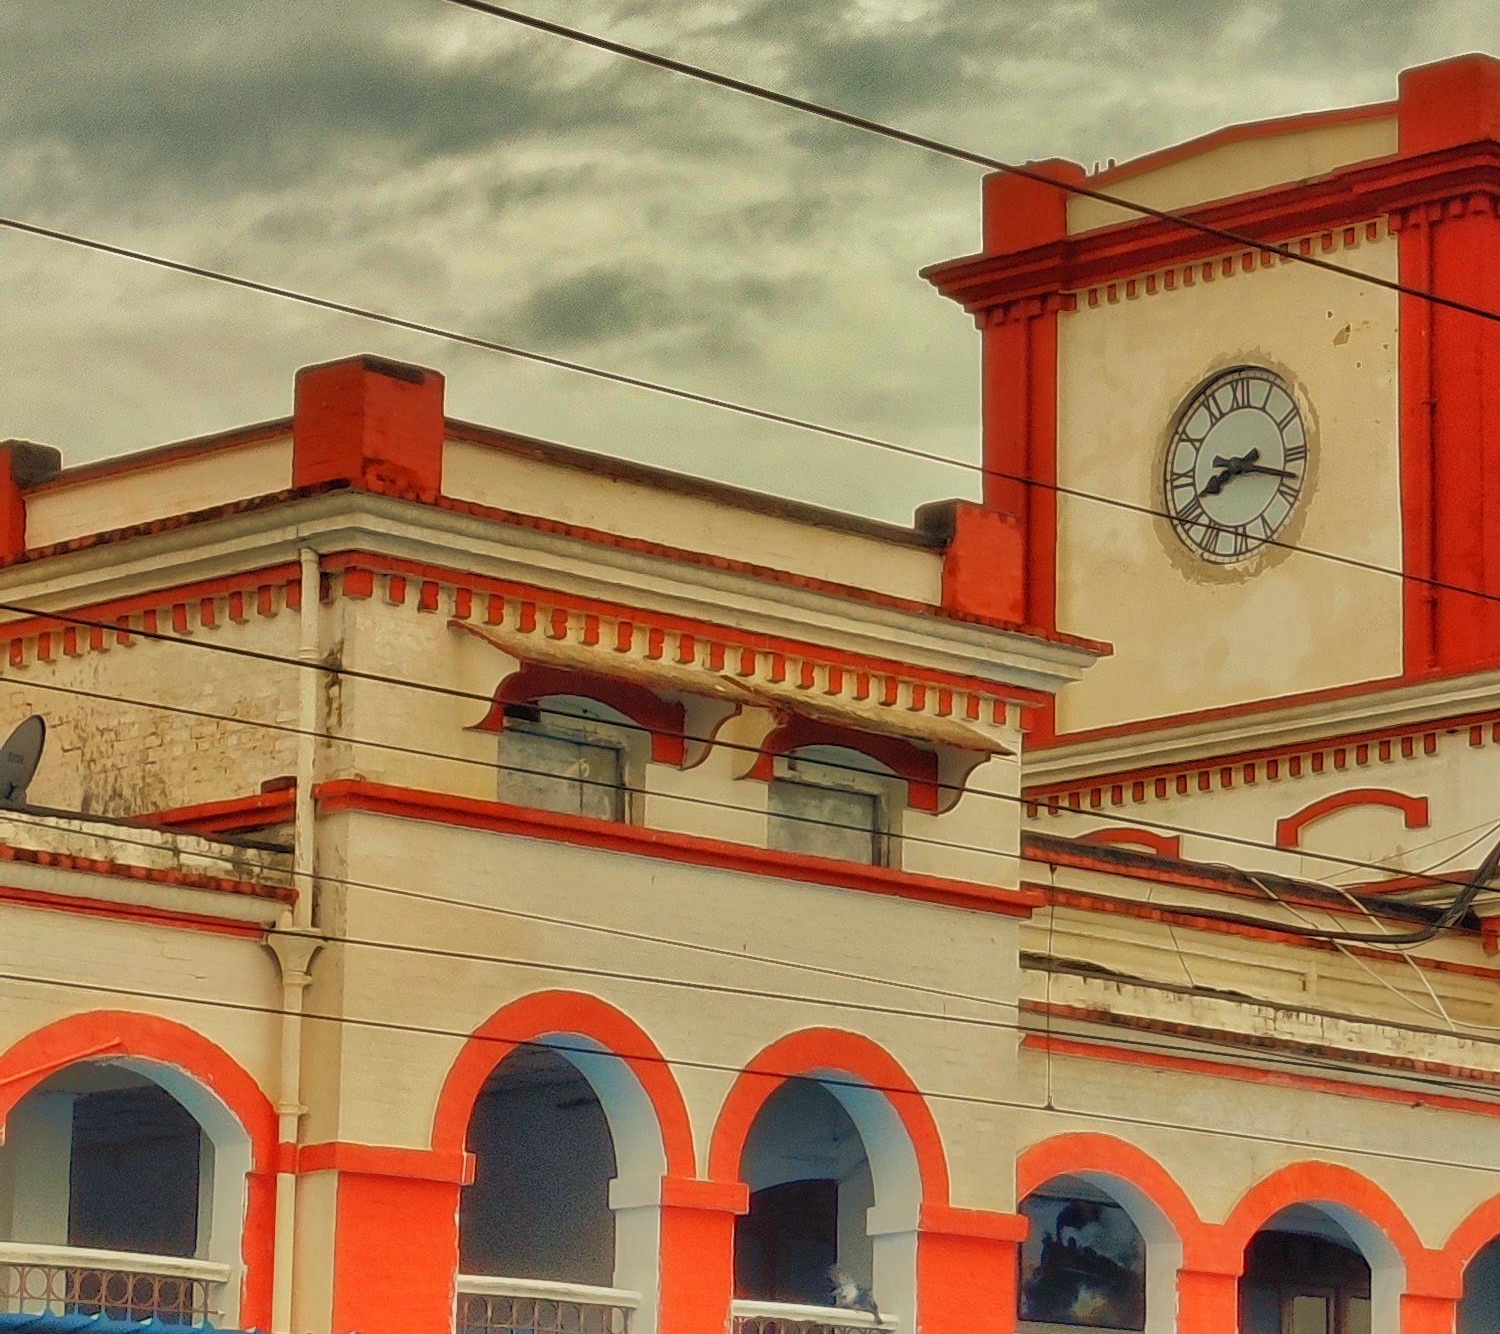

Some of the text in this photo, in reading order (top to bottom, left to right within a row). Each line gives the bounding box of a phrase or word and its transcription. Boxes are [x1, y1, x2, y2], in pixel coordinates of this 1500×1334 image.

[1230, 379, 1250, 408] XII
[1263, 383, 1274, 410] I
[1202, 394, 1224, 426] XI
[1277, 406, 1299, 430] II
[1180, 430, 1204, 452] X
[1284, 444, 1306, 464] III
[1171, 467, 1195, 490] IX
[1277, 481, 1300, 506] IV
[1200, 519, 1220, 554] VII
[1260, 513, 1275, 540] V
[1233, 525, 1249, 556] VI
